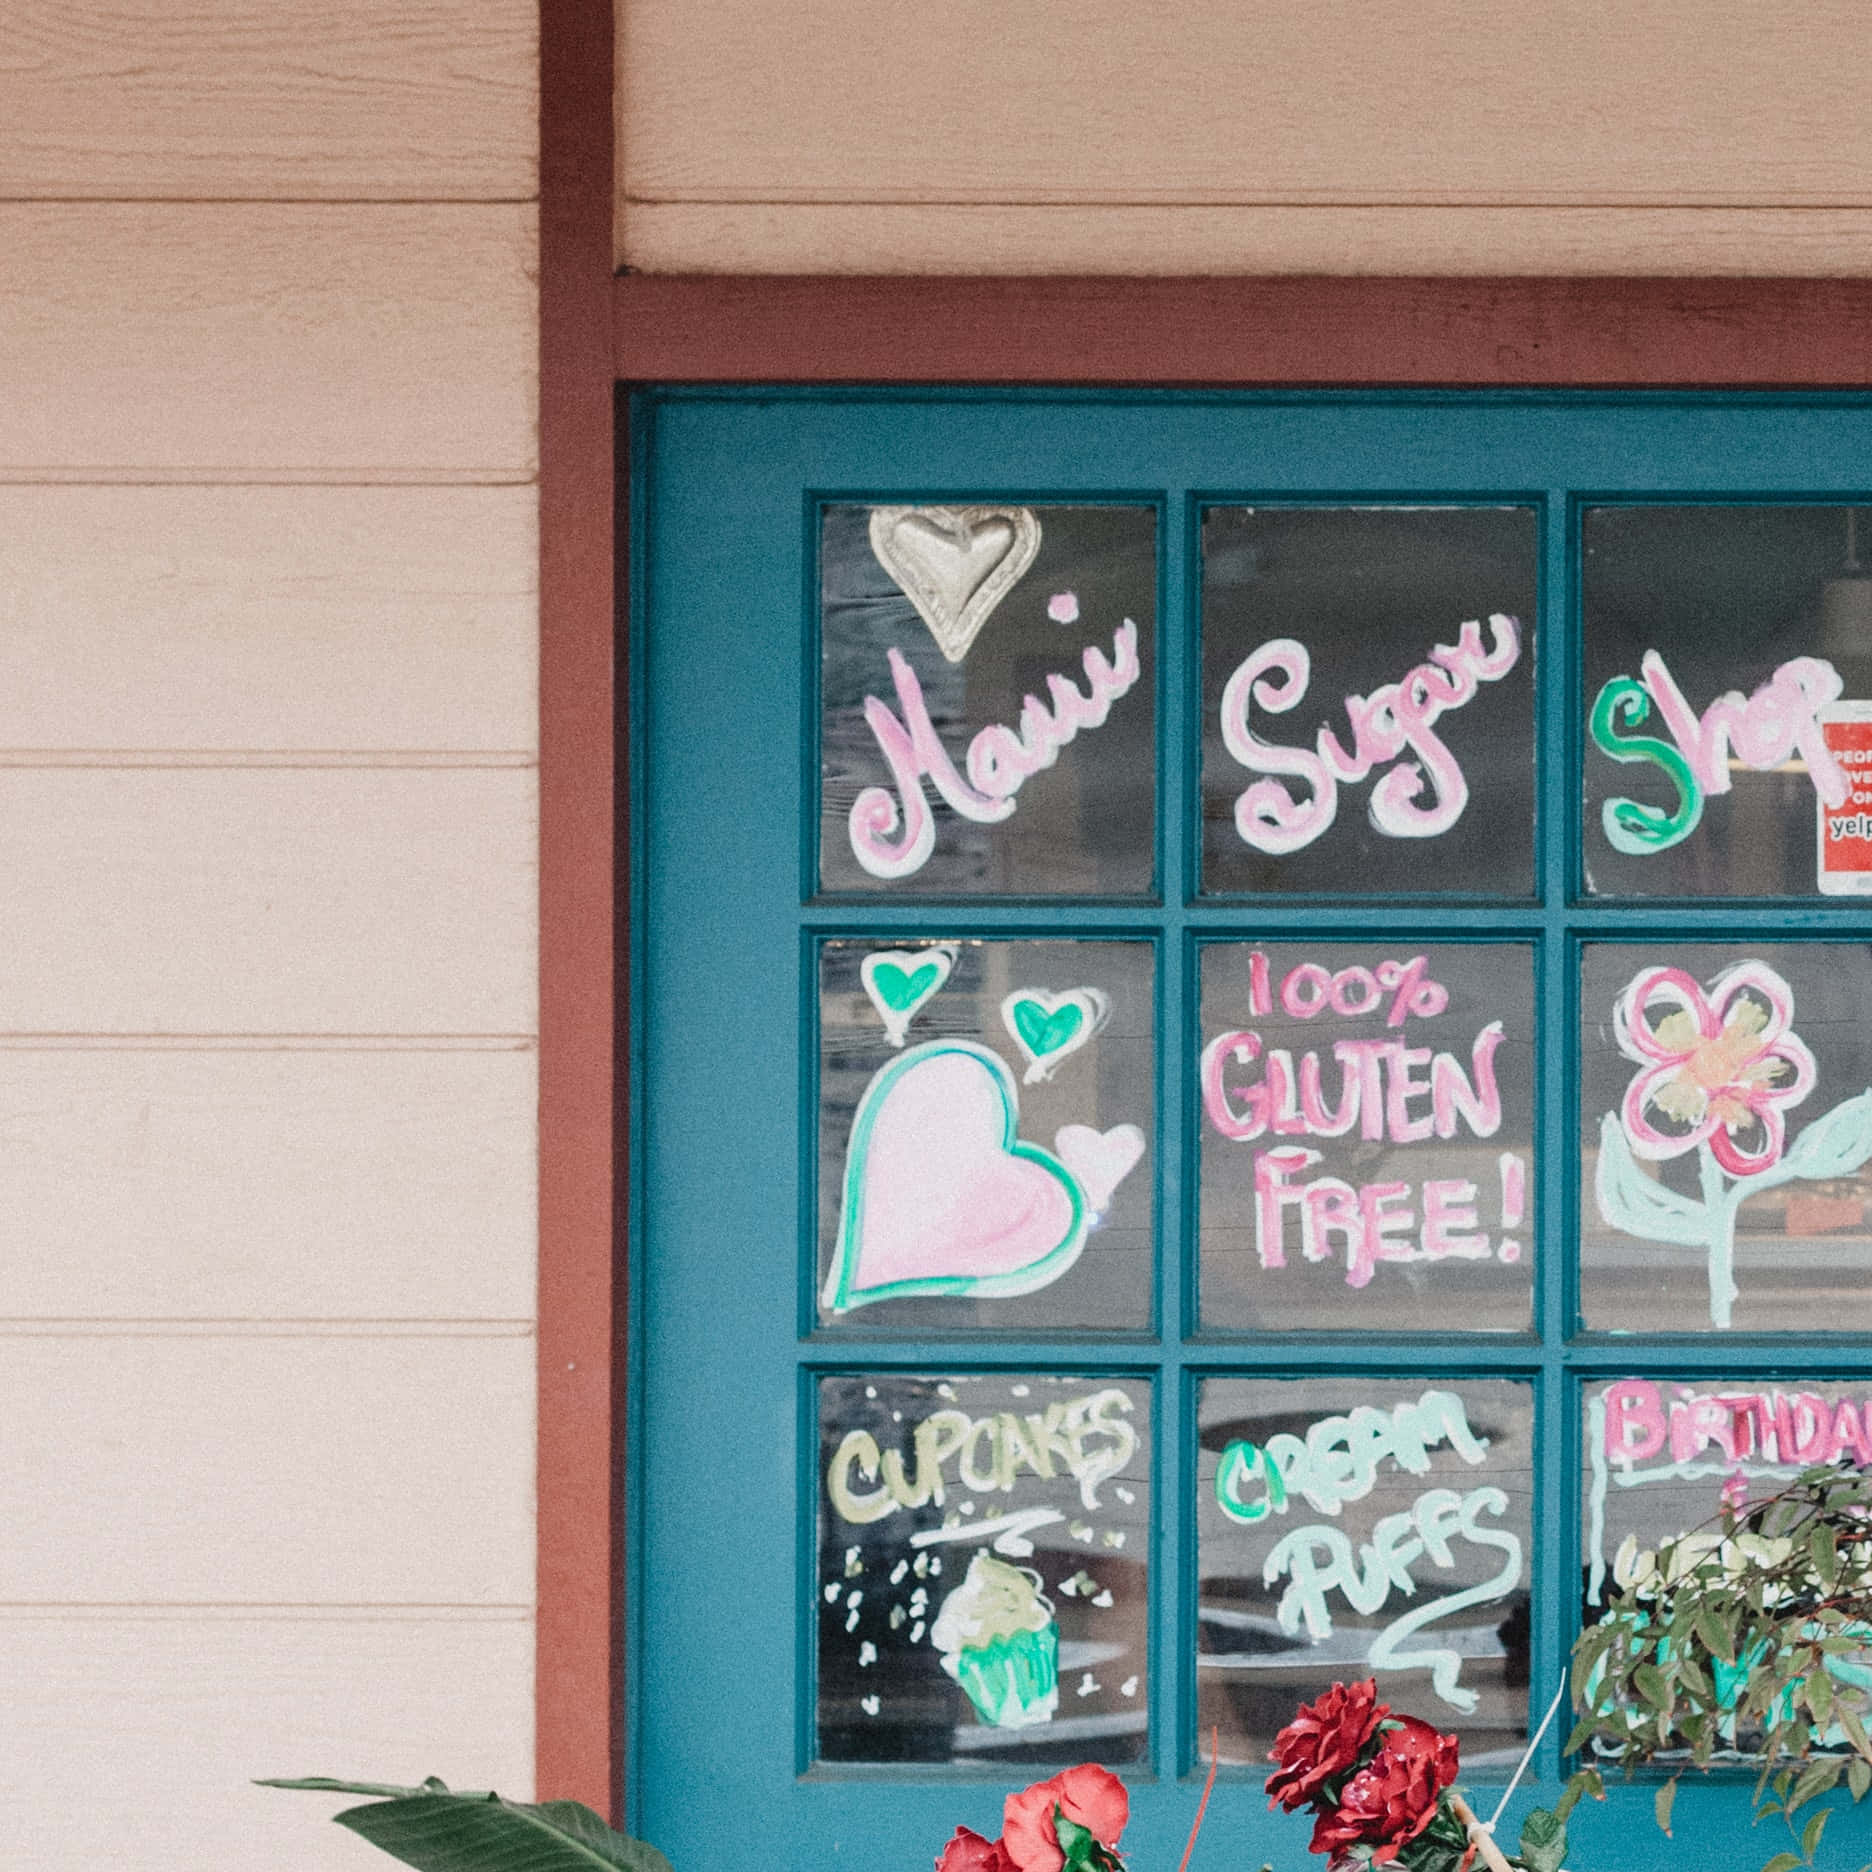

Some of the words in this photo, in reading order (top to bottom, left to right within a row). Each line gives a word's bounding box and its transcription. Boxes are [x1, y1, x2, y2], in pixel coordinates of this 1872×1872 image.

[849, 591, 1139, 878] Maui
[1220, 613, 1521, 854] Sugar
[1591, 649, 1854, 854] Shop
[1249, 951, 1449, 1028] 100%
[1201, 1020, 1506, 1143] GLUTEN
[1255, 1145, 1525, 1288] FREE!
[828, 1388, 1141, 1524] CUPCAKES
[1215, 1390, 1490, 1524] CREAM
[1264, 1486, 1523, 1715] PUFFS
